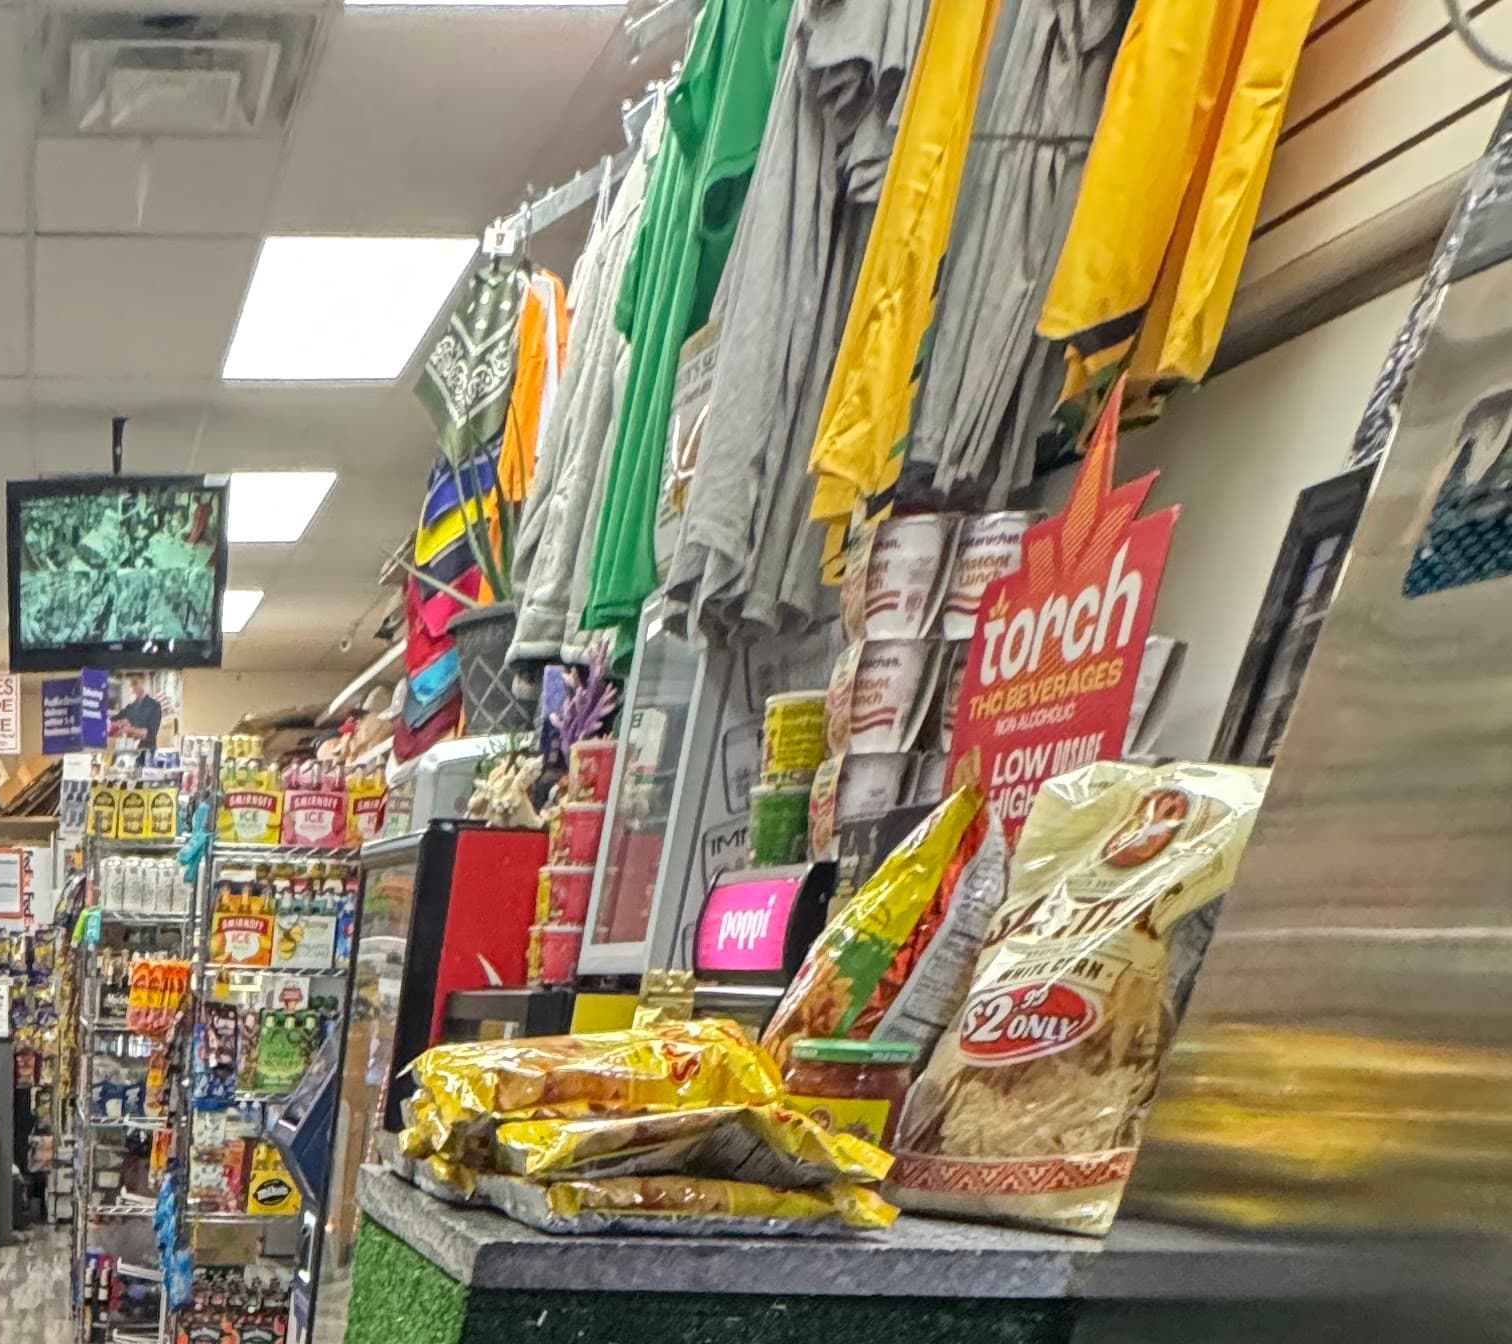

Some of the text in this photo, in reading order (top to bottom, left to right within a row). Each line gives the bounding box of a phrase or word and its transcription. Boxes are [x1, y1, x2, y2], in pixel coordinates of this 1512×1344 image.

[980, 537, 1143, 686] torch
[1000, 657, 1125, 713] BEVERAGES
[1017, 702, 1077, 731] ALCOHOLIC
[990, 742, 1053, 787] LOW
[229, 794, 273, 809] SMIRNOFF
[294, 796, 338, 810] SMIRNOFF
[357, 799, 380, 811] SMIR
[240, 810, 258, 822] ICE
[305, 812, 324, 823] ICE
[221, 918, 265, 931] SMIRNOFF
[717, 894, 777, 950] poppi
[996, 960, 1048, 983] WHITE
[1007, 1014, 1080, 1042] ONLY
